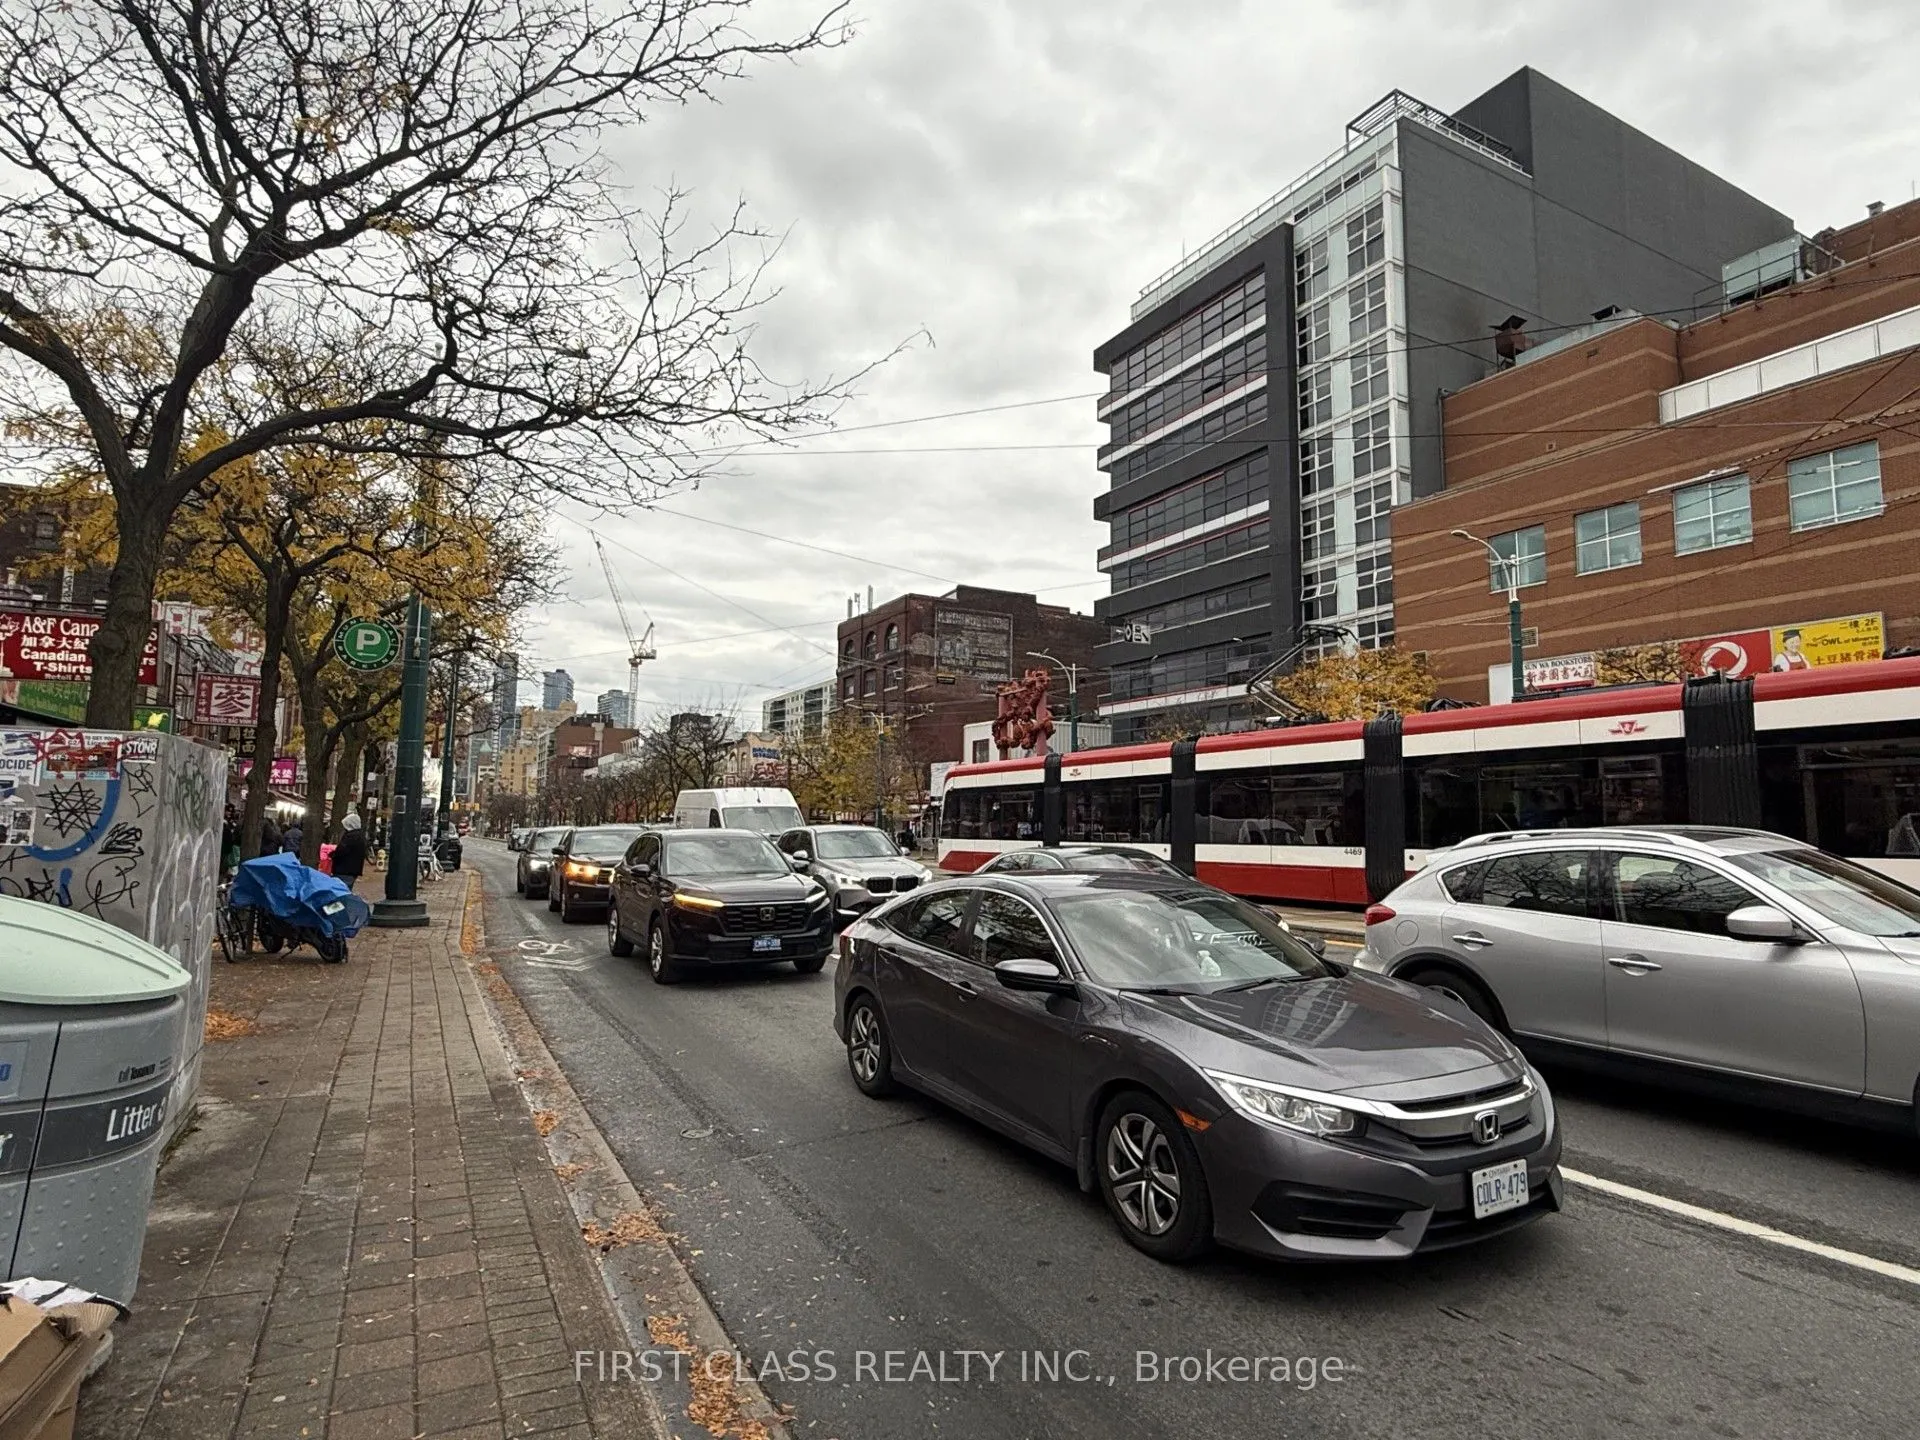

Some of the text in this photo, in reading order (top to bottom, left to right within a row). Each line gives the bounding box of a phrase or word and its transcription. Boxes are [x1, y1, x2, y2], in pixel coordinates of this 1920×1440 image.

[21, 616, 56, 634] A&F
[356, 629, 381, 651] P
[1822, 637, 1843, 646] OWL
[21, 648, 86, 663] Canadian
[34, 661, 93, 674] T-Shirts
[106, 1102, 157, 1142] Litter
[1508, 1171, 1527, 1196] 479
